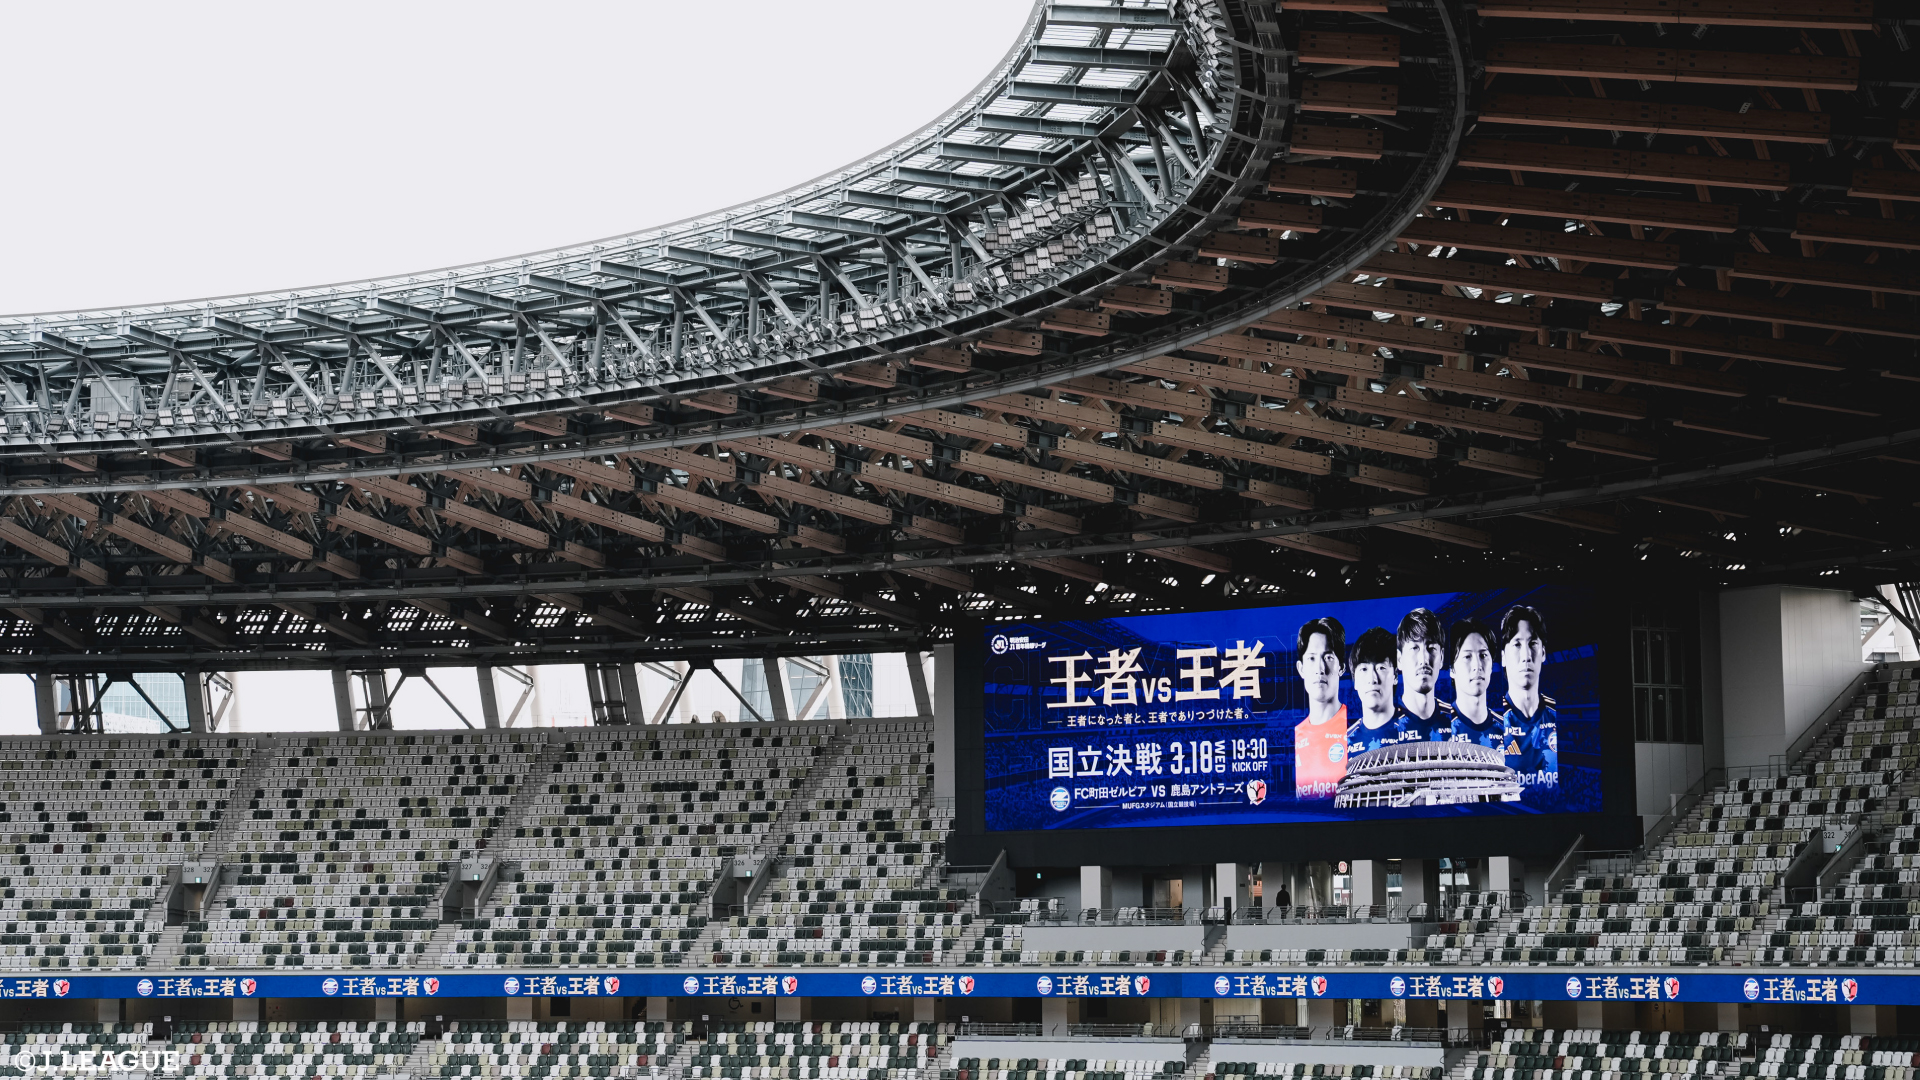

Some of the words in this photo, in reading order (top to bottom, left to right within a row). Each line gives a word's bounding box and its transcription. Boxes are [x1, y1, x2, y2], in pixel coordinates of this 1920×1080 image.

[1067, 707, 1249, 727] 王者になった者と、王者でありつづけた者。
[1214, 740, 1226, 773] WED
[1231, 738, 1268, 760] 19:30
[1048, 742, 1162, 779] 国立決戦
[1170, 740, 1213, 774] 3.18
[1232, 761, 1251, 772] KICK
[1252, 761, 1269, 771] OFF
[1074, 786, 1147, 799] FC町田ゼルビア
[1151, 785, 1166, 797] VS
[1170, 781, 1245, 796] 鹿島アントラーズ
[0, 979, 49, 997] VS王者
